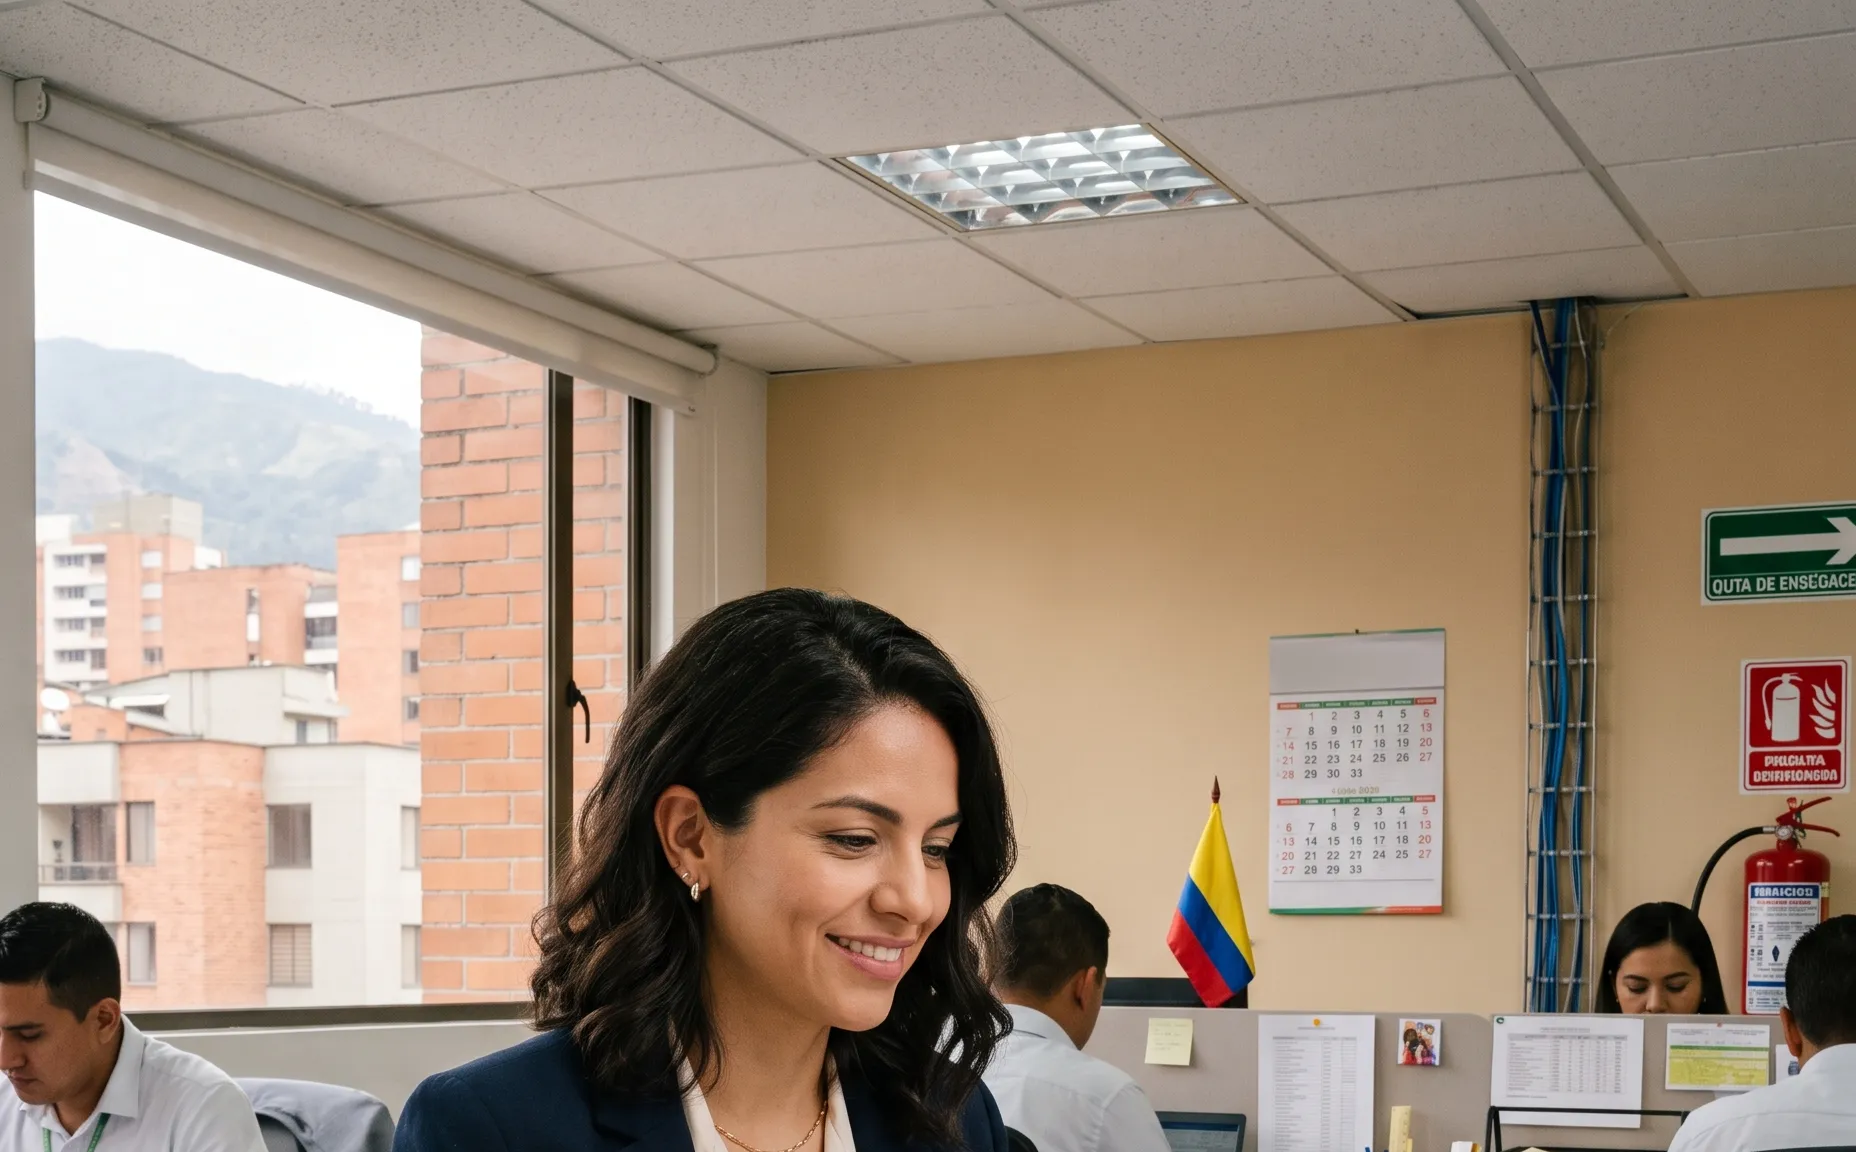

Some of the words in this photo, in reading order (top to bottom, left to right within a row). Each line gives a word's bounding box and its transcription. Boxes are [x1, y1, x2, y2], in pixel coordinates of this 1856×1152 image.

[1756, 576, 1776, 592] DE
[1308, 712, 1314, 721] 1
[1331, 711, 1338, 720] 2
[1353, 711, 1361, 719] 3
[1376, 710, 1384, 718] 4
[1400, 709, 1407, 718] 5
[1423, 709, 1430, 717] 6
[1286, 727, 1293, 736] 7
[1308, 727, 1315, 735] 8
[1330, 726, 1338, 735] 9
[1352, 725, 1362, 734] 10
[1374, 725, 1384, 733] 11
[1397, 724, 1409, 732] 12
[1421, 723, 1432, 732] 13
[1284, 742, 1294, 750] 14
[1306, 741, 1317, 750] 15
[1328, 740, 1340, 749] 16
[1351, 740, 1362, 748] 17
[1374, 739, 1385, 748] 18
[1397, 738, 1409, 747] 19
[1420, 738, 1432, 747] 20
[1283, 756, 1293, 765] 21
[1305, 755, 1317, 764] 22
[1327, 755, 1339, 764] 23
[1350, 754, 1362, 763] 24
[1373, 754, 1386, 762] 25
[1397, 753, 1409, 762] 26
[1420, 752, 1432, 761] 27
[1282, 770, 1294, 779] 28
[1305, 770, 1317, 778] 29
[1327, 769, 1340, 778] 30
[1351, 769, 1362, 778] 33
[1331, 808, 1337, 816] 1
[1353, 807, 1361, 816] 2
[1376, 807, 1383, 815] 3
[1398, 806, 1406, 815] 4
[1421, 806, 1429, 815] 5
[1285, 823, 1293, 832] 6
[1308, 822, 1316, 831] 7
[1330, 822, 1338, 831] 8
[1353, 821, 1361, 830] 9
[1374, 821, 1385, 830] 10
[1397, 821, 1407, 829] 11
[1420, 820, 1431, 829] 13
[1283, 837, 1294, 846] 13
[1306, 837, 1317, 845] 14
[1328, 837, 1340, 845] 15
[1351, 836, 1362, 845] 16
[1374, 836, 1385, 844] 17
[1397, 835, 1408, 844] 18
[1419, 835, 1431, 844] 20
[1282, 852, 1294, 860] 20
[1305, 852, 1316, 860] 21
[1327, 851, 1339, 860] 22
[1350, 851, 1361, 859] 27
[1373, 850, 1385, 859] 24
[1396, 850, 1408, 858] 25
[1419, 849, 1431, 858] 27
[1282, 866, 1294, 874] 27
[1305, 865, 1317, 874] 28
[1327, 865, 1339, 874] 29
[1350, 865, 1362, 874] 33
